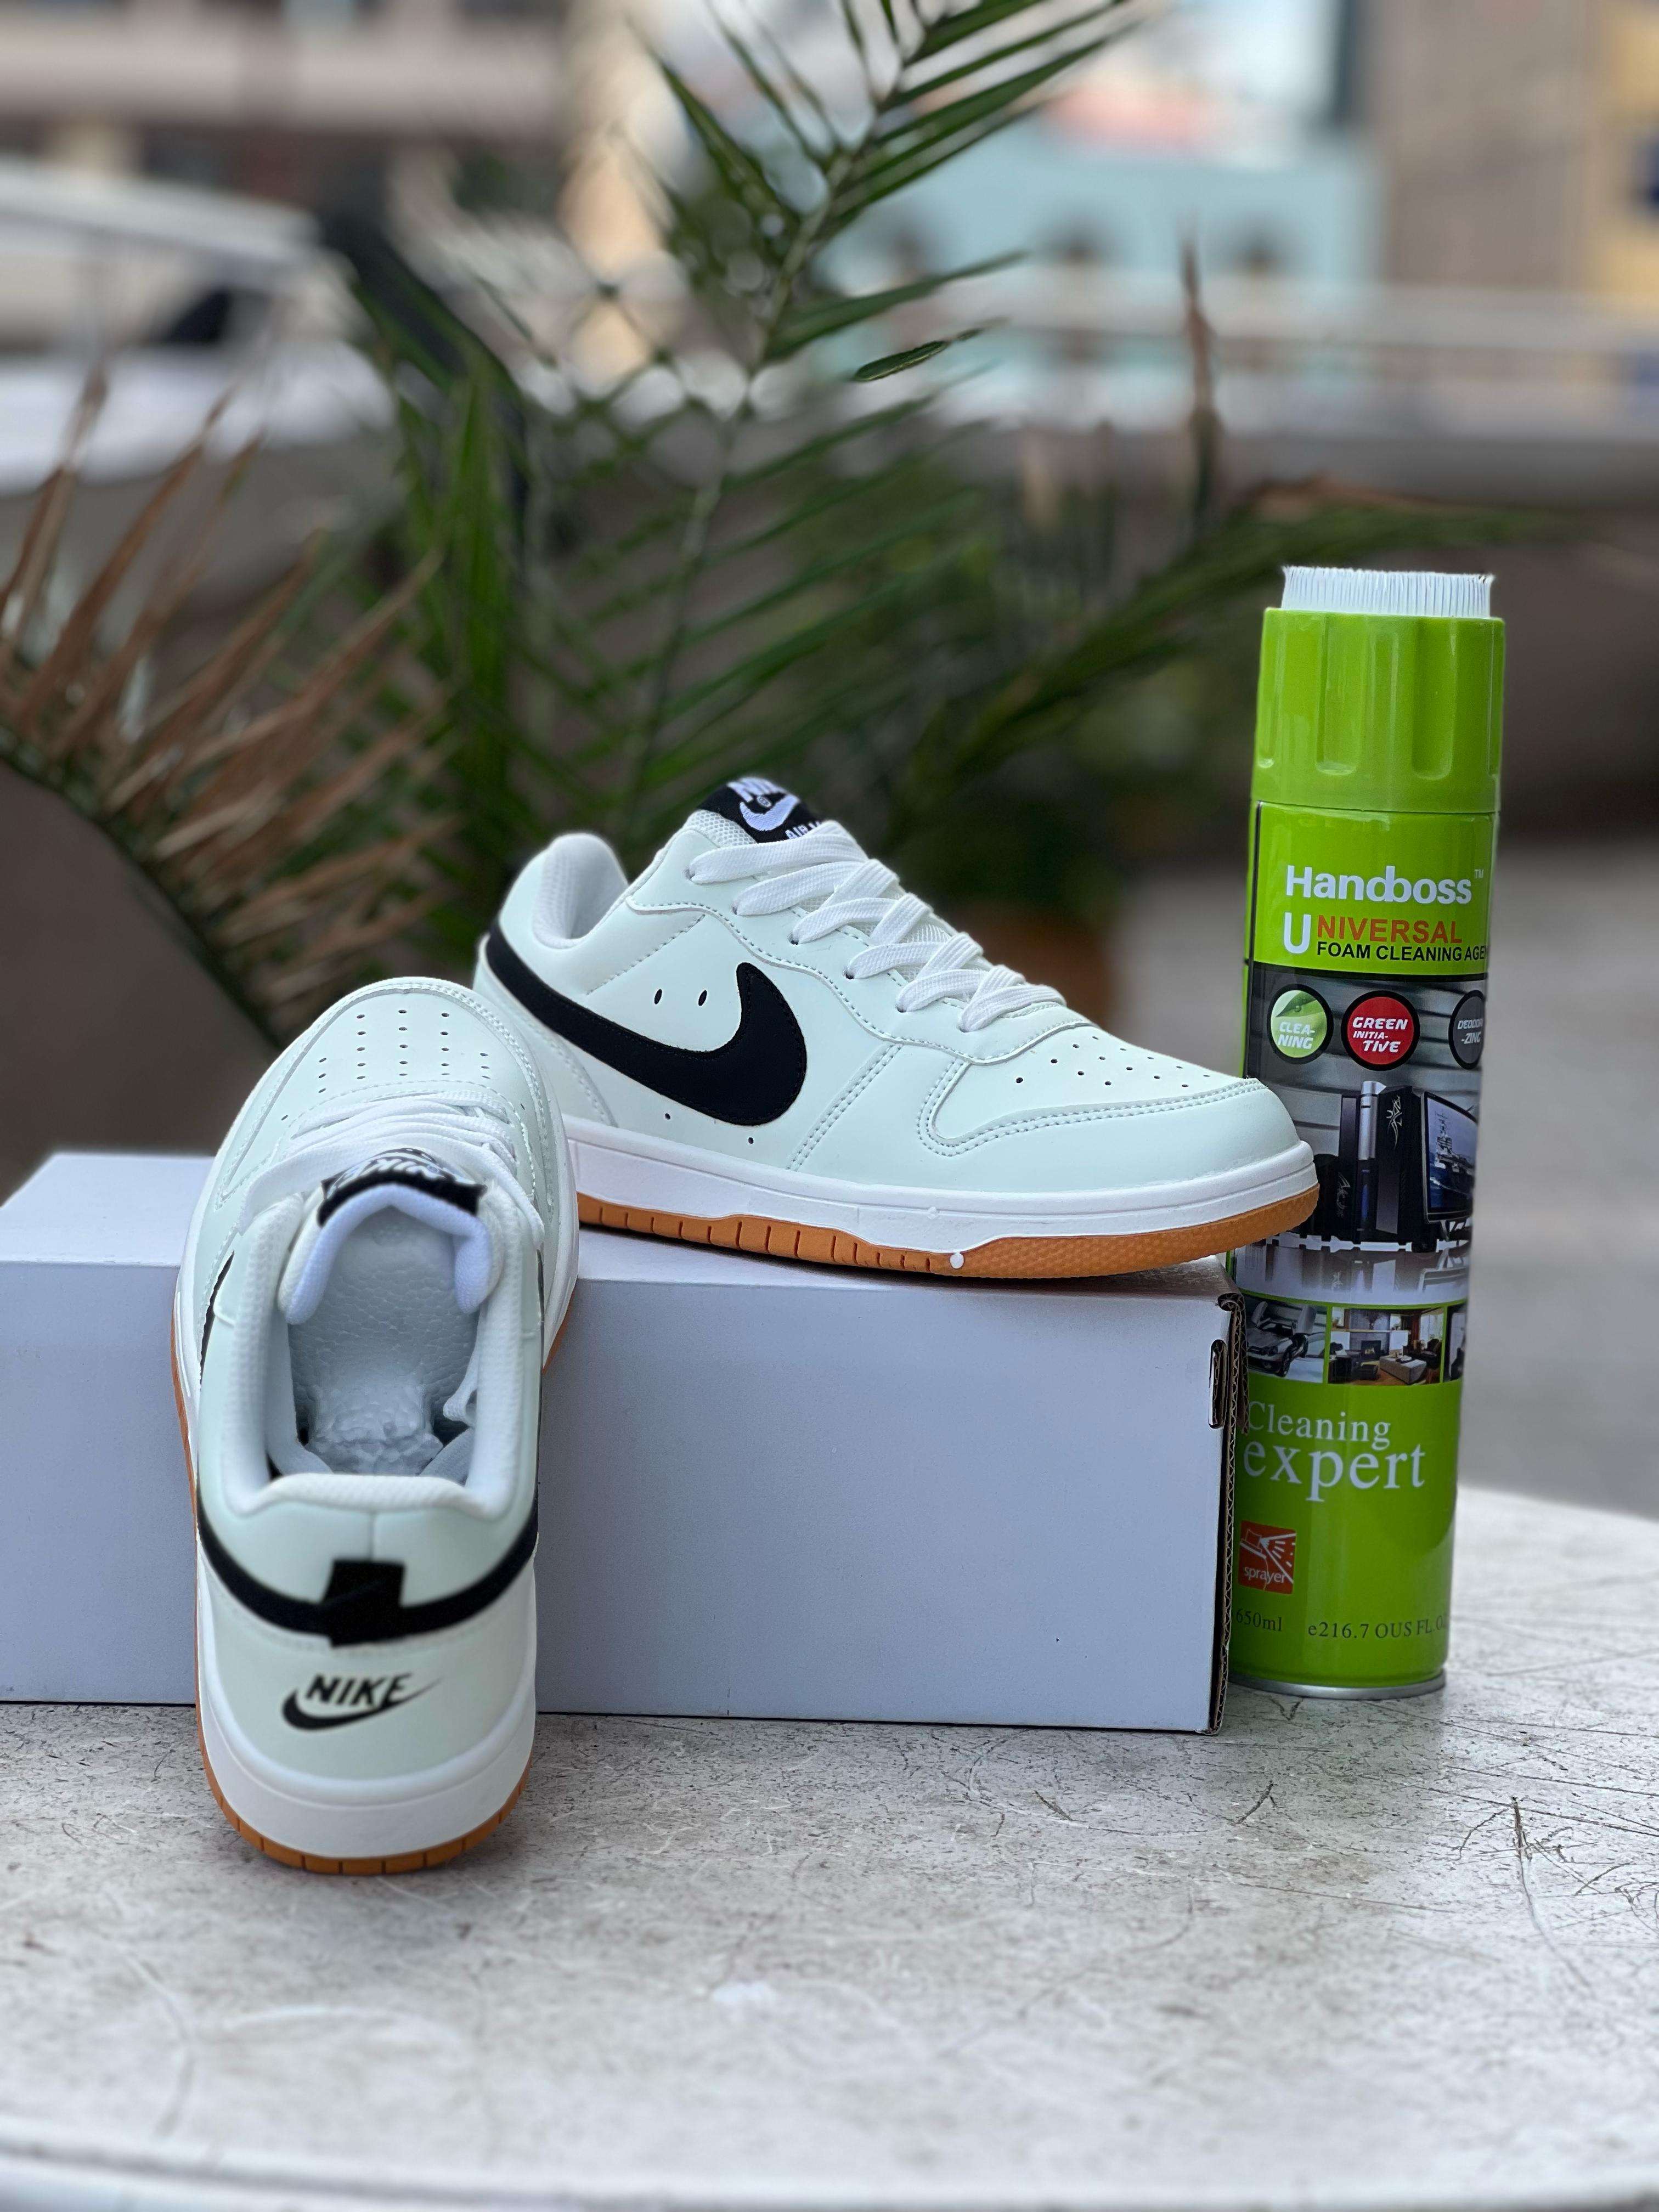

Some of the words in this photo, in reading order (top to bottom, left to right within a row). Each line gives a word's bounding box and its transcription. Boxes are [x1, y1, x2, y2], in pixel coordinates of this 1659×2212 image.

[1286, 865, 1472, 904] Handboss
[1317, 941, 1371, 959] FOAM
[1376, 944, 1462, 961] CLEANING
[1279, 1021, 1316, 1035] CLEA-
[1352, 1017, 1408, 1030] GREEN
[1277, 1034, 1313, 1049] NING
[1352, 1030, 1389, 1039] INITIA-
[1363, 1040, 1401, 1053] TIVE
[1248, 1401, 1391, 1451] Cleaning
[1243, 1441, 1426, 1503] expert
[1244, 1566, 1285, 1584] sprayer
[1236, 1608, 1282, 1632] 650ml
[306, 1671, 413, 1711] NIKE
